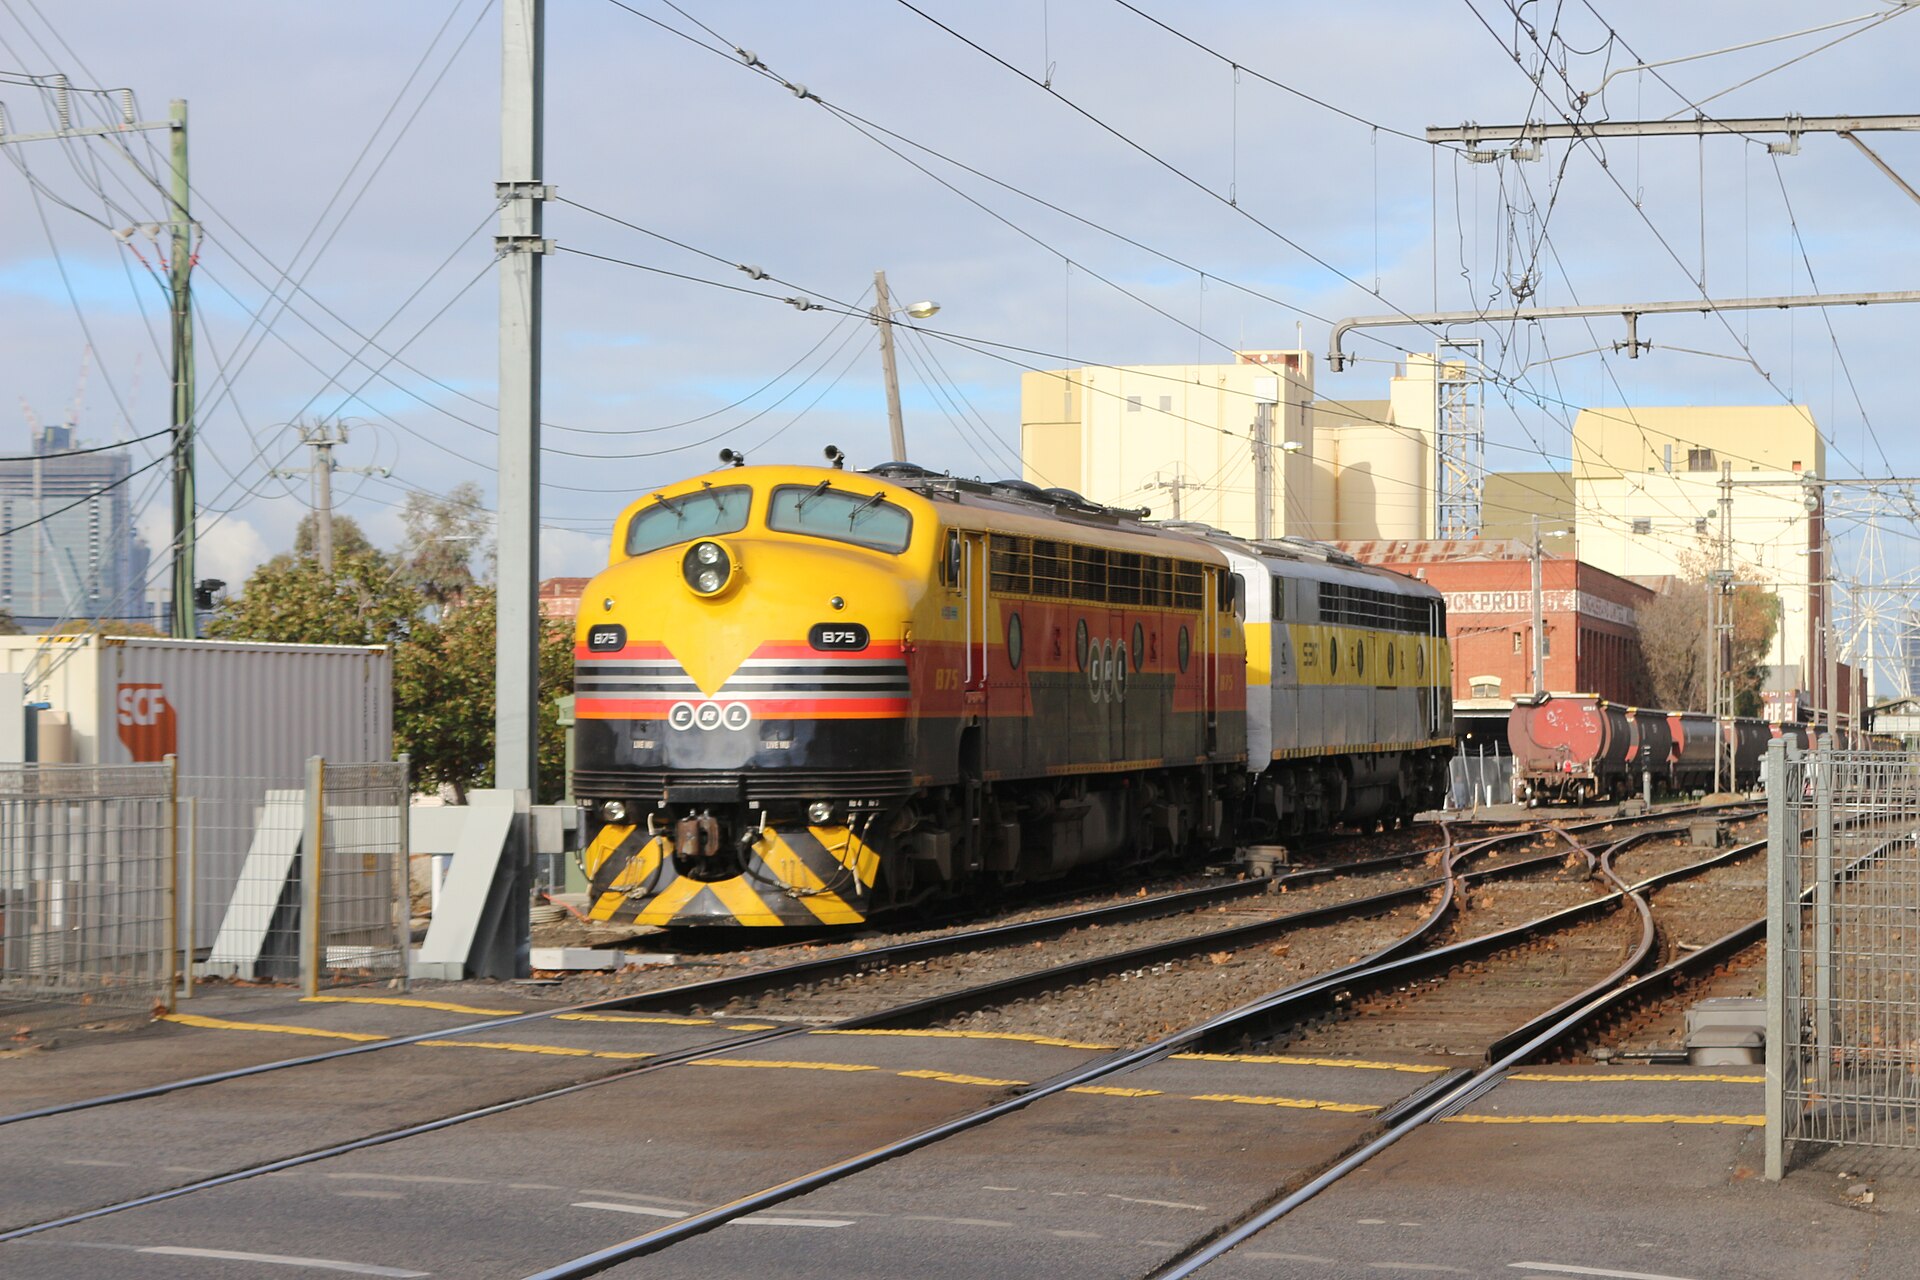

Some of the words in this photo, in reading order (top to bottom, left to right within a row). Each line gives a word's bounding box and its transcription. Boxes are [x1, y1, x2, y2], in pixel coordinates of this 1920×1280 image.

[593, 632, 618, 644] B75
[822, 631, 856, 643] B75
[936, 668, 959, 690] B75
[118, 688, 164, 726] SCF
